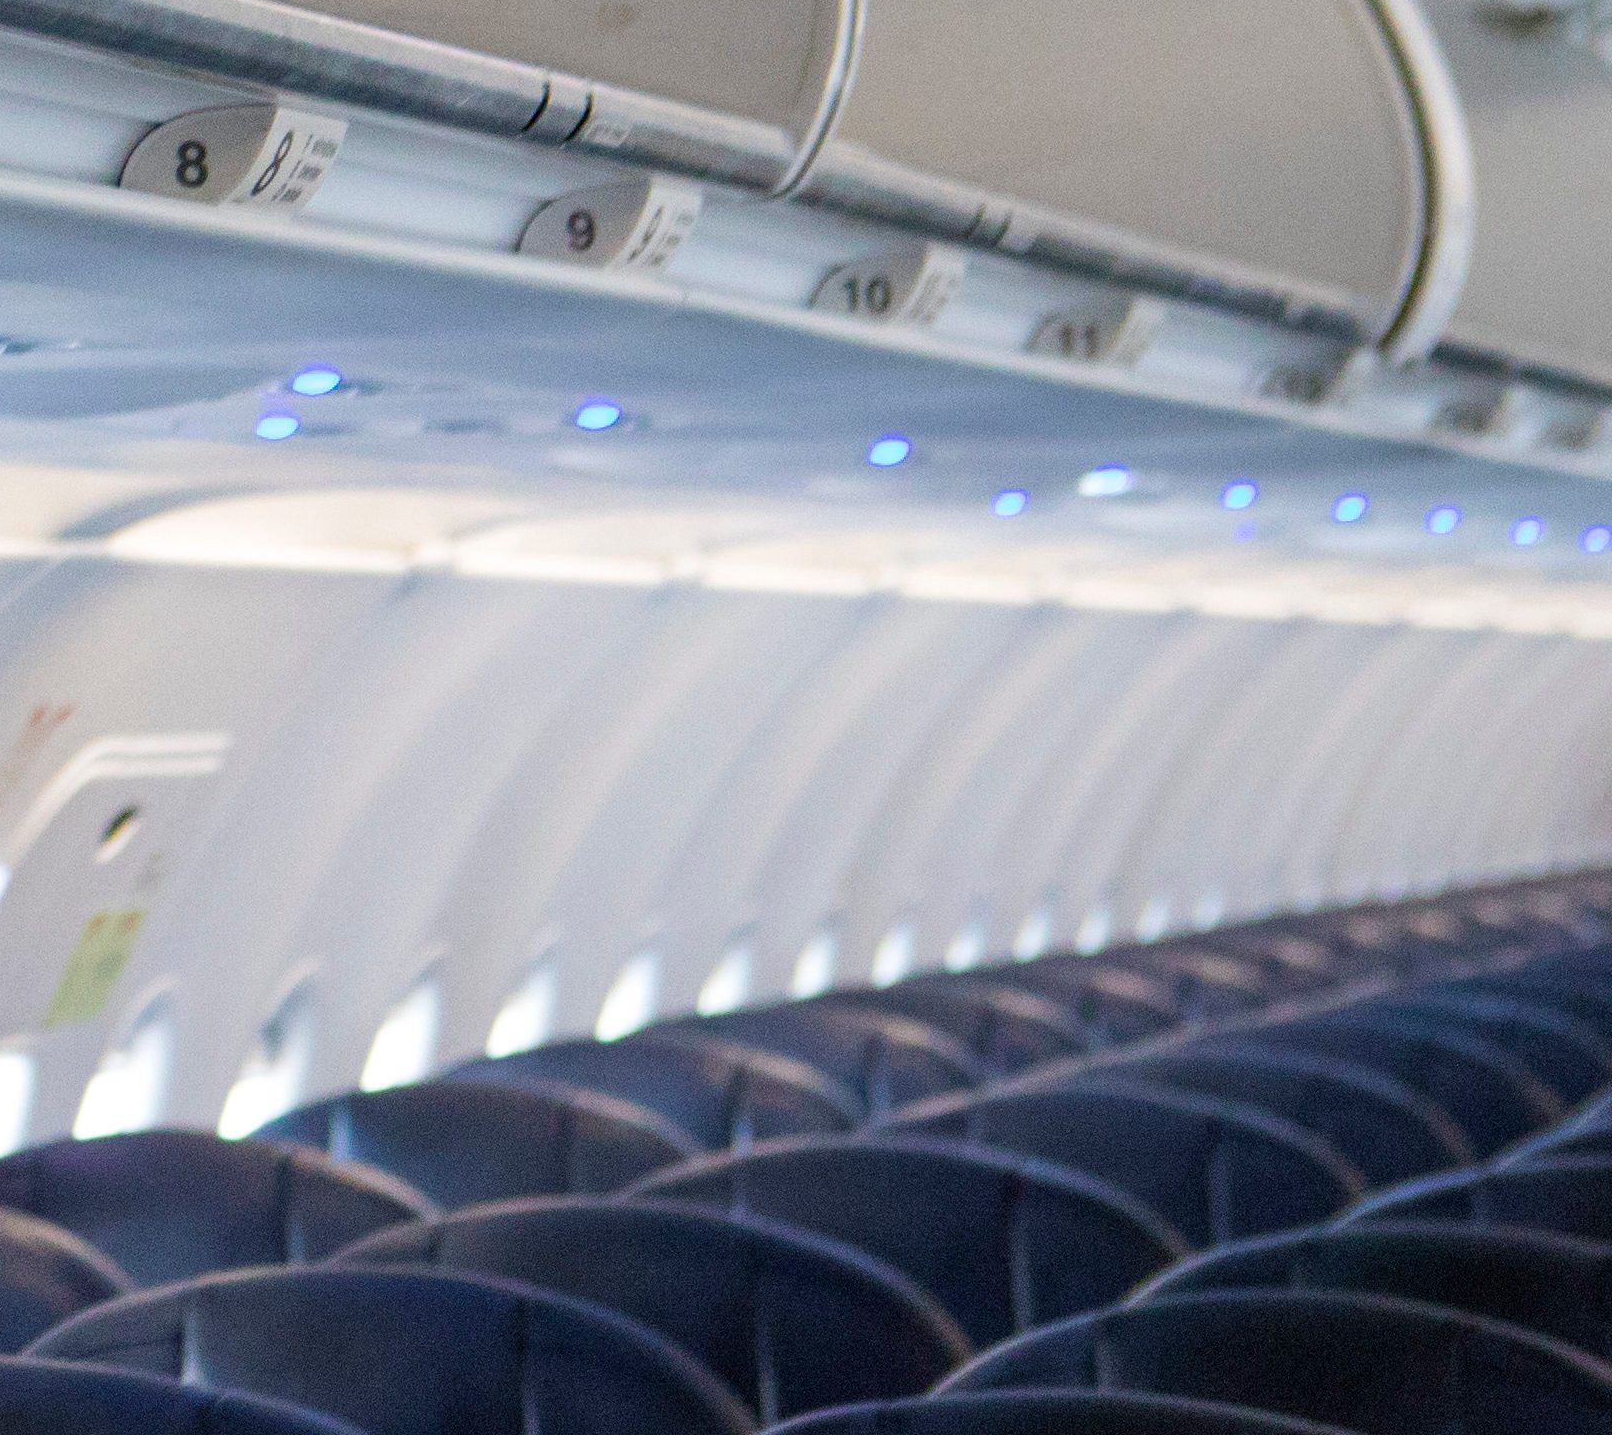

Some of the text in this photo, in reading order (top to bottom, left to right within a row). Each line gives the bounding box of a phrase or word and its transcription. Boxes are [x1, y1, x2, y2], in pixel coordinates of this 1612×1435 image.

[174, 140, 209, 189] 8
[249, 129, 295, 198] 8
[567, 209, 595, 252] 9
[841, 271, 895, 317] 10
